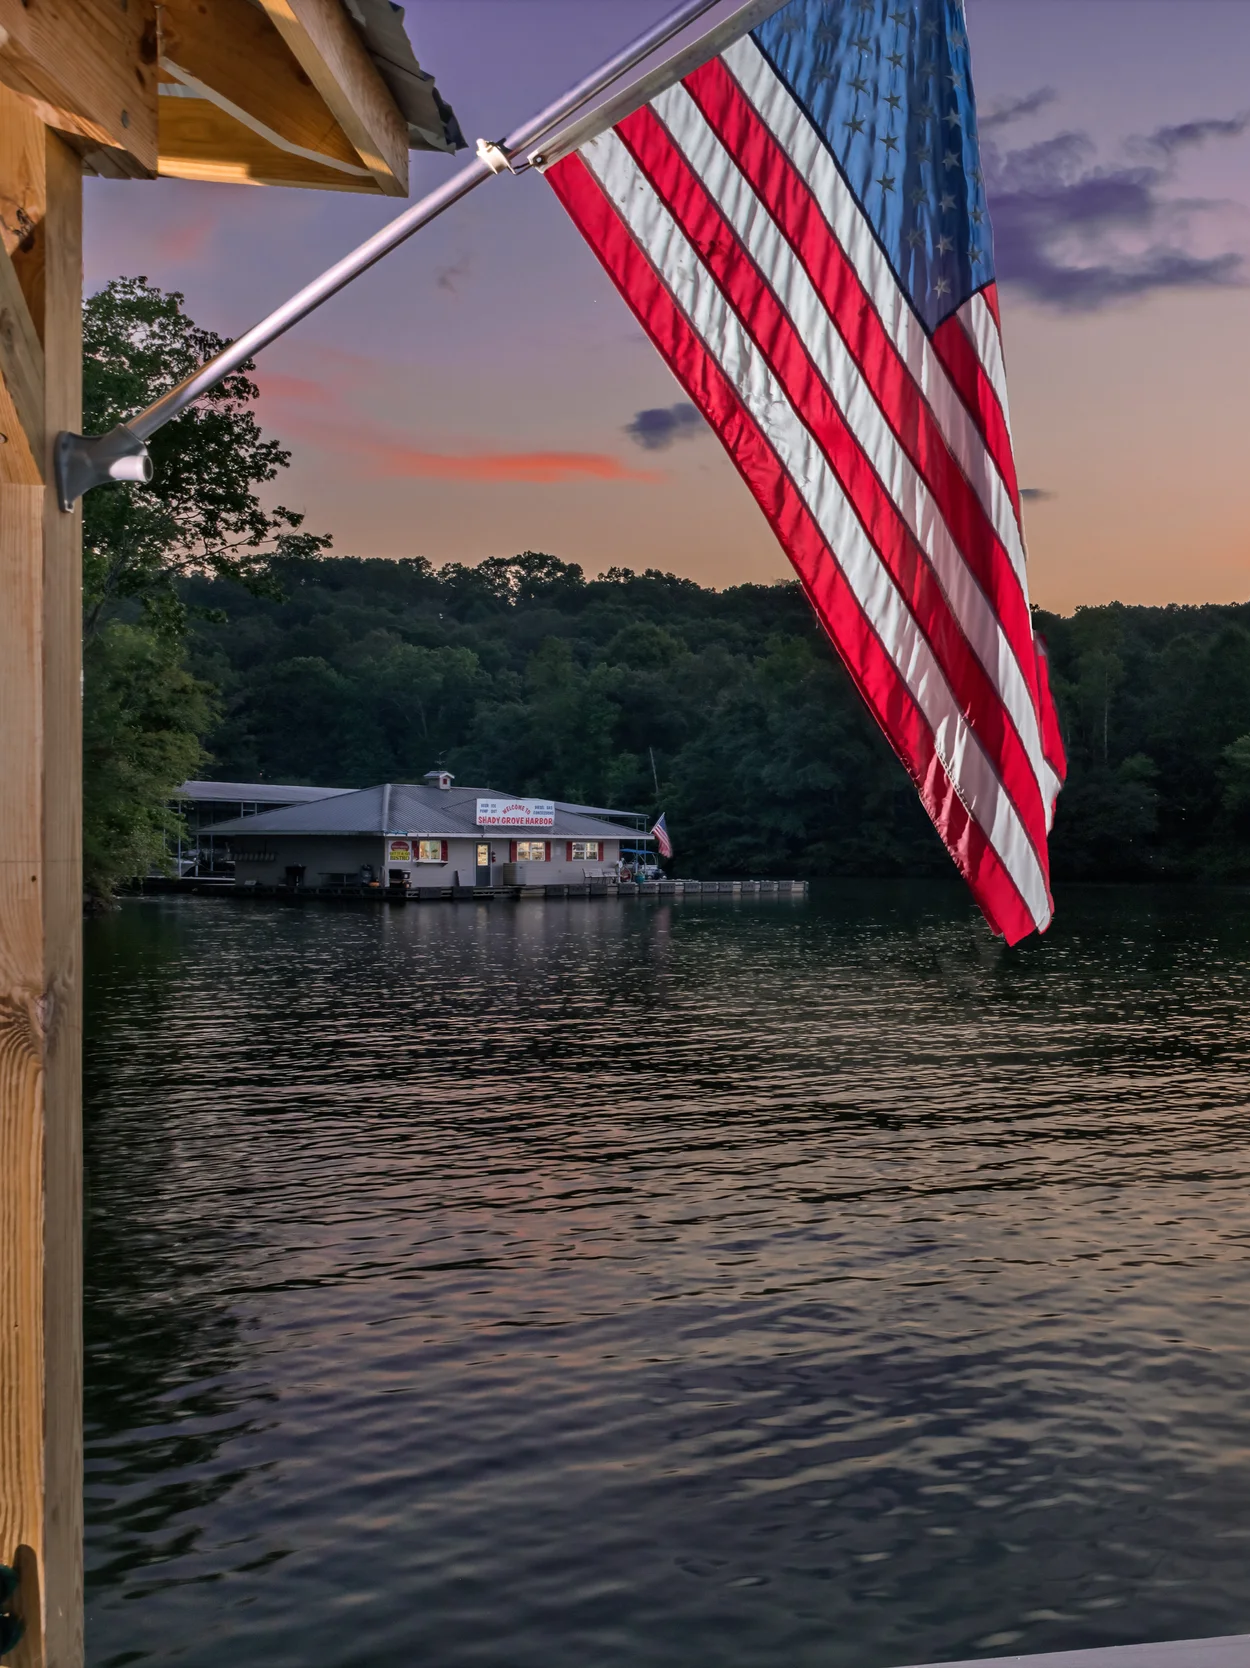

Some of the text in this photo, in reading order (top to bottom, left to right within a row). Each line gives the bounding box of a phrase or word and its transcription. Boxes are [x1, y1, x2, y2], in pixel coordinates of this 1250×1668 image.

[502, 804, 531, 815] WELCOME TO
[478, 816, 500, 824] SHADY
[525, 817, 553, 825] HARBOR
